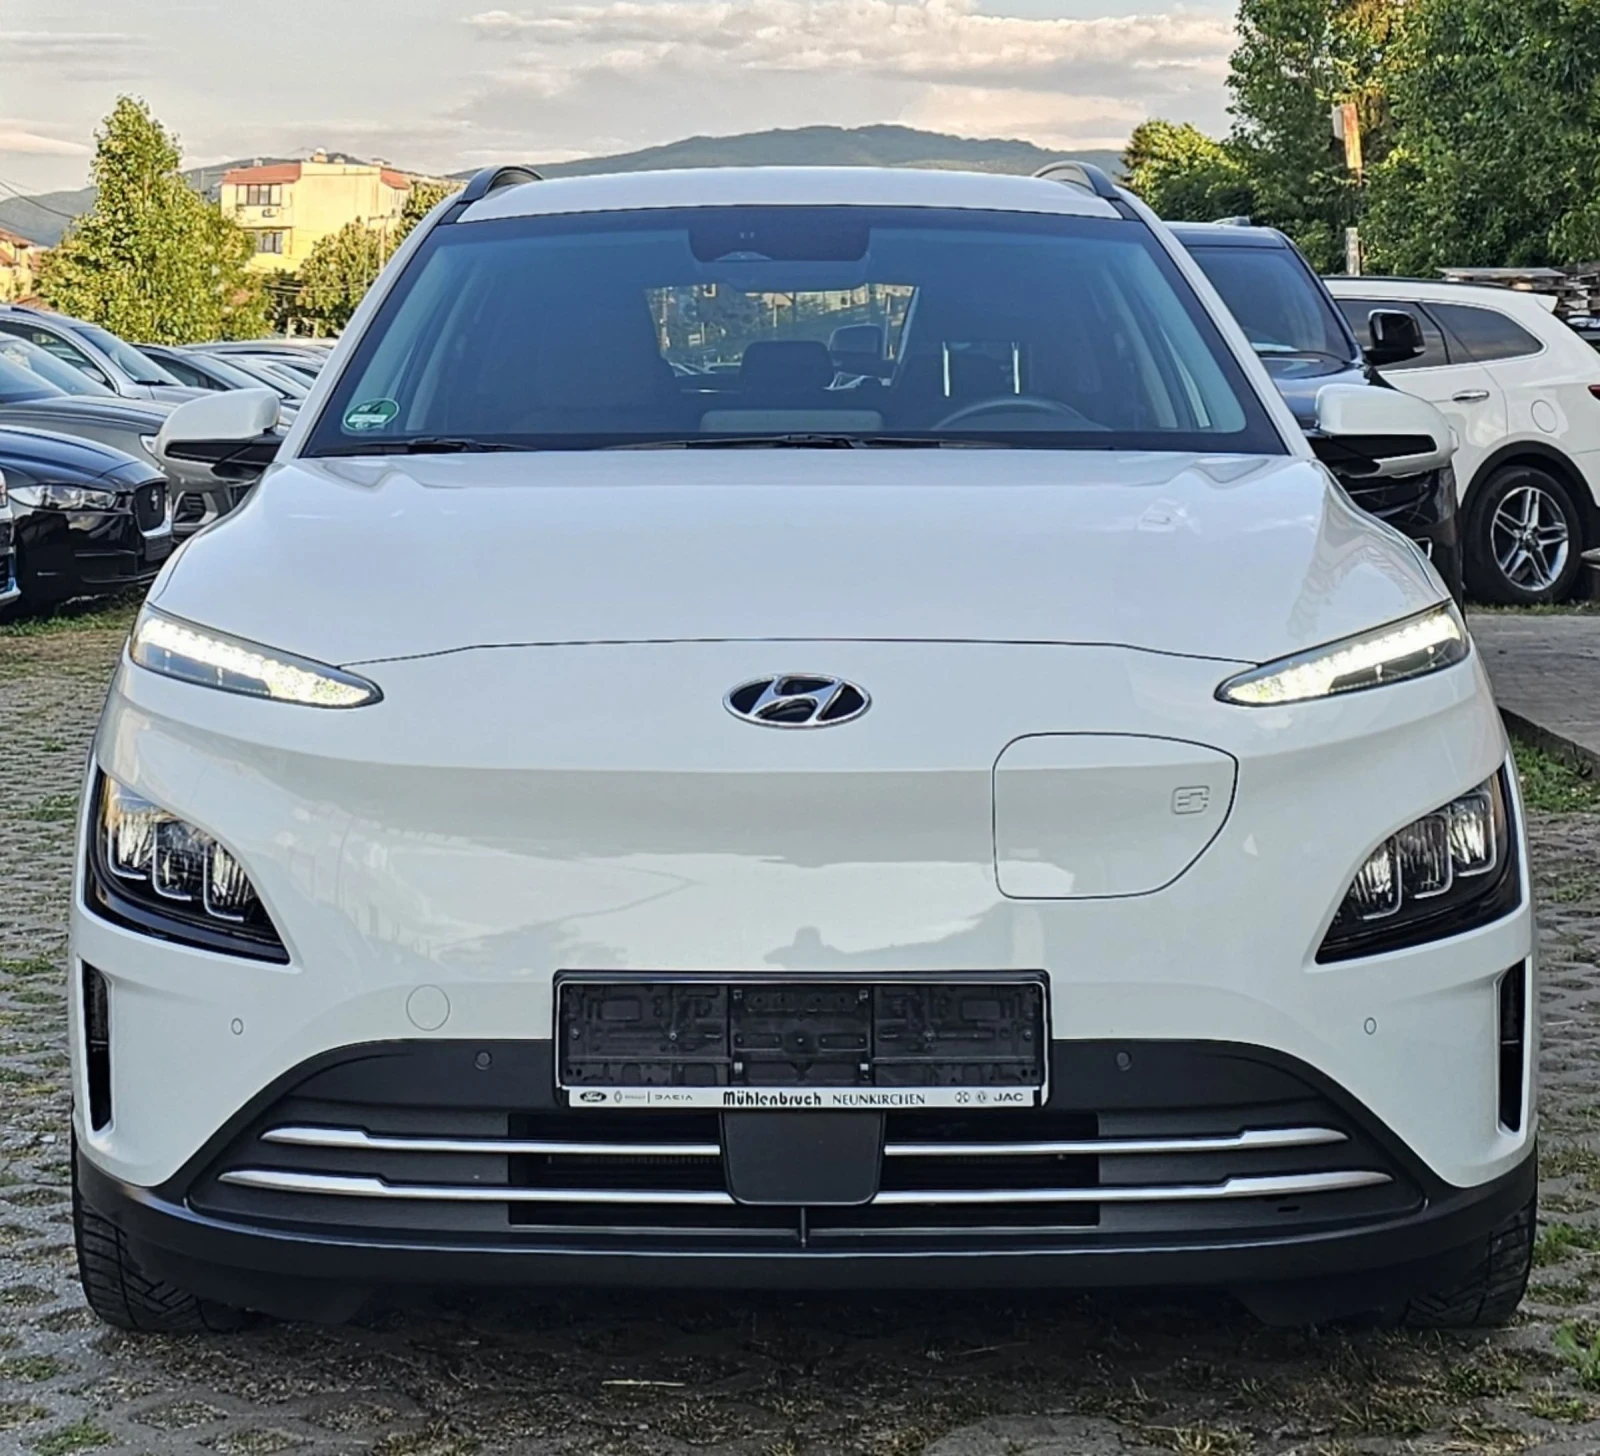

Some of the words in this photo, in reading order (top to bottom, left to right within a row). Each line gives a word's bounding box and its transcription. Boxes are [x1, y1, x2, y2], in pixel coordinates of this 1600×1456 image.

[723, 1090, 822, 1106] Mühlenbruch
[832, 1093, 926, 1106] NEUNKIRCHEN
[993, 1092, 1024, 1102] JAC
